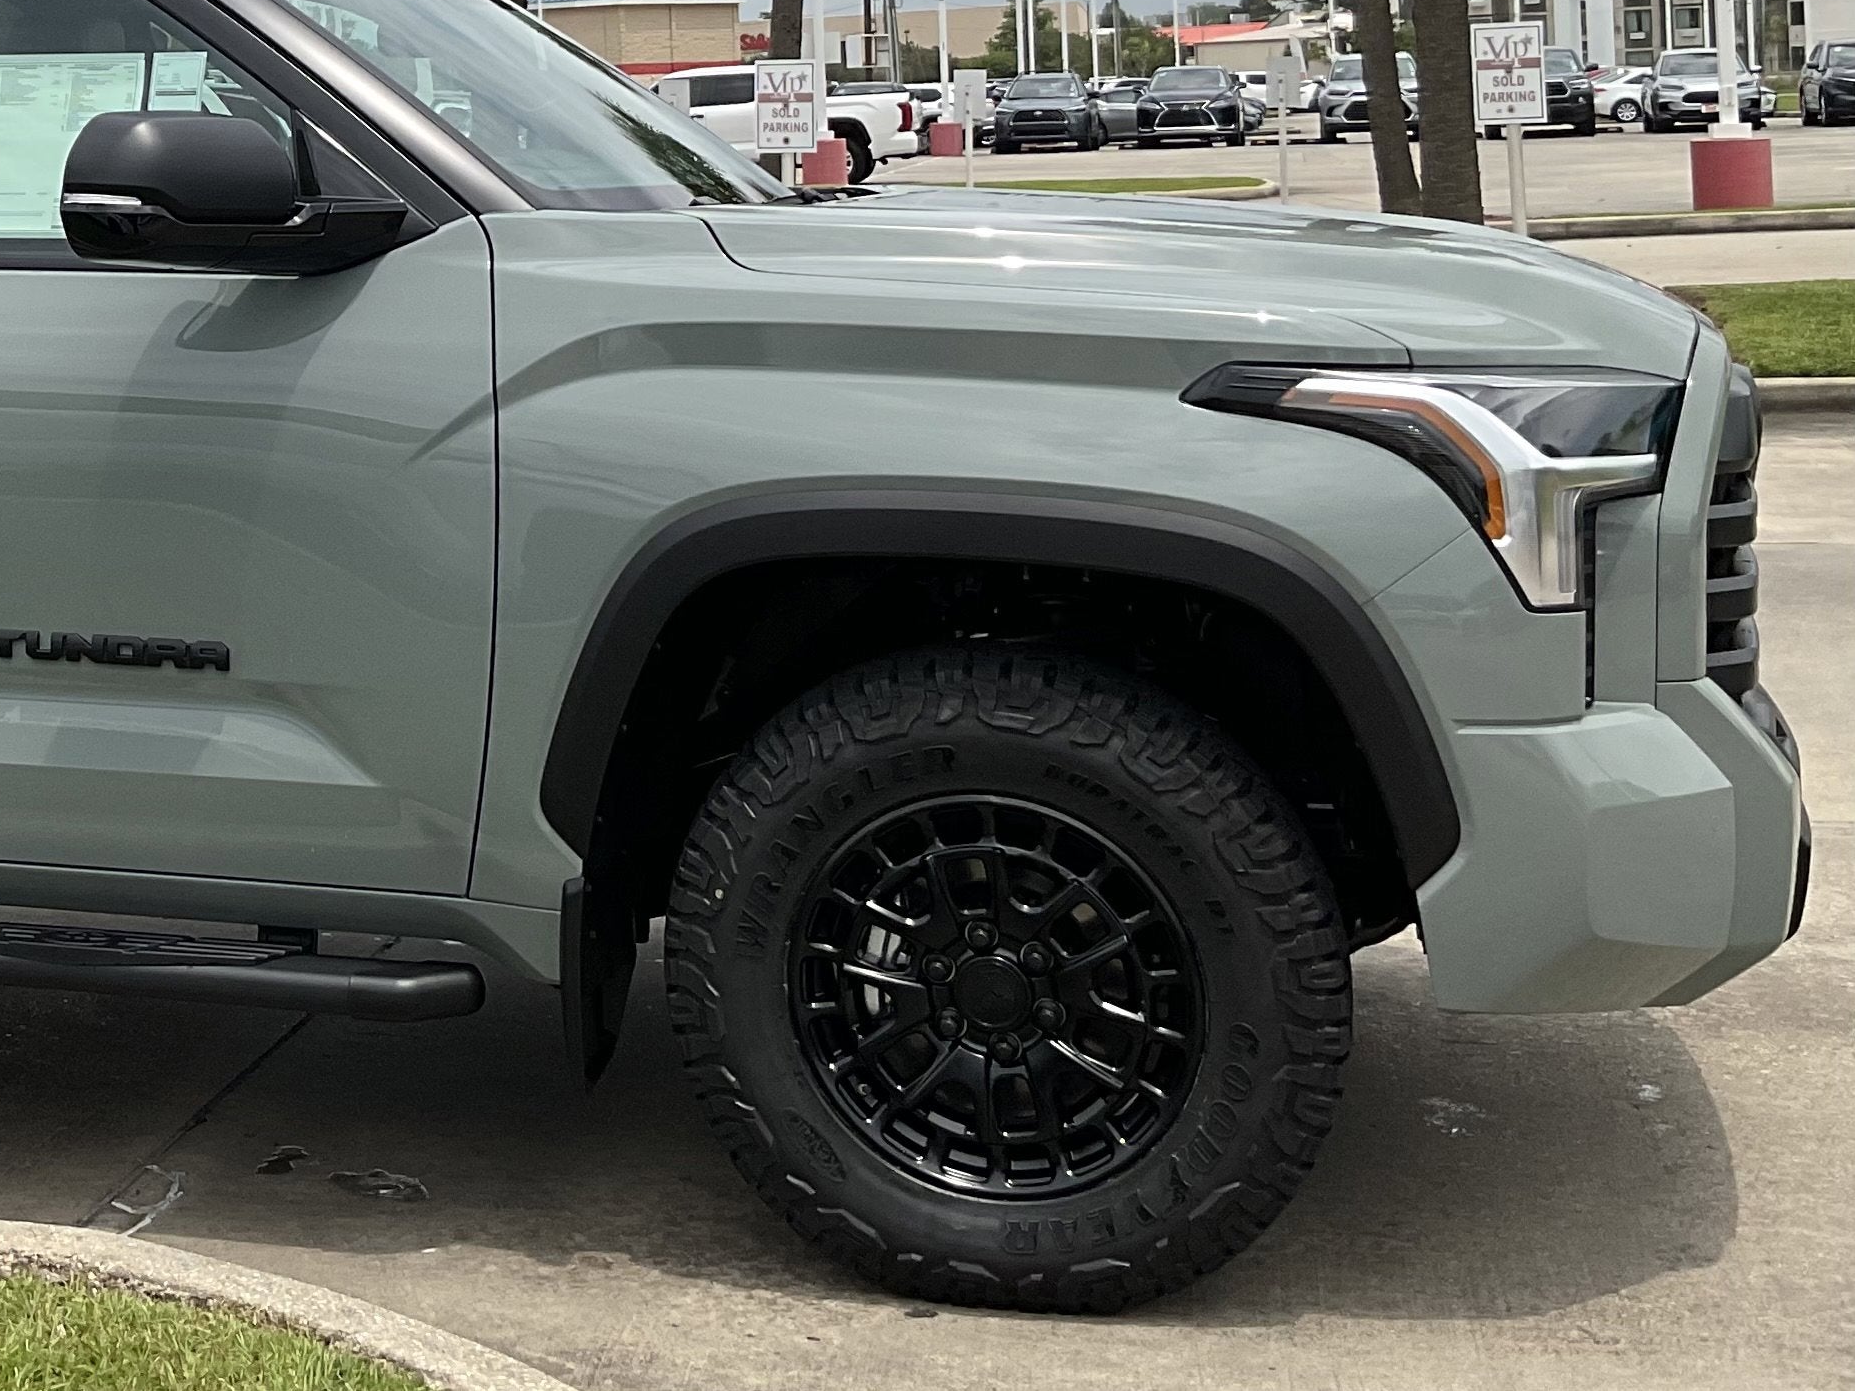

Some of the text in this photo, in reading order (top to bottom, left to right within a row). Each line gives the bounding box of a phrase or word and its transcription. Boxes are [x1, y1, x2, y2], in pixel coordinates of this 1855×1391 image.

[1492, 75, 1525, 87] SOLD
[1482, 90, 1536, 104] PARKING
[771, 107, 800, 119] SOLD
[762, 121, 809, 133] PARKING
[736, 744, 958, 956] WRANGLER
[1003, 1021, 1261, 1255] GOODYEAR
